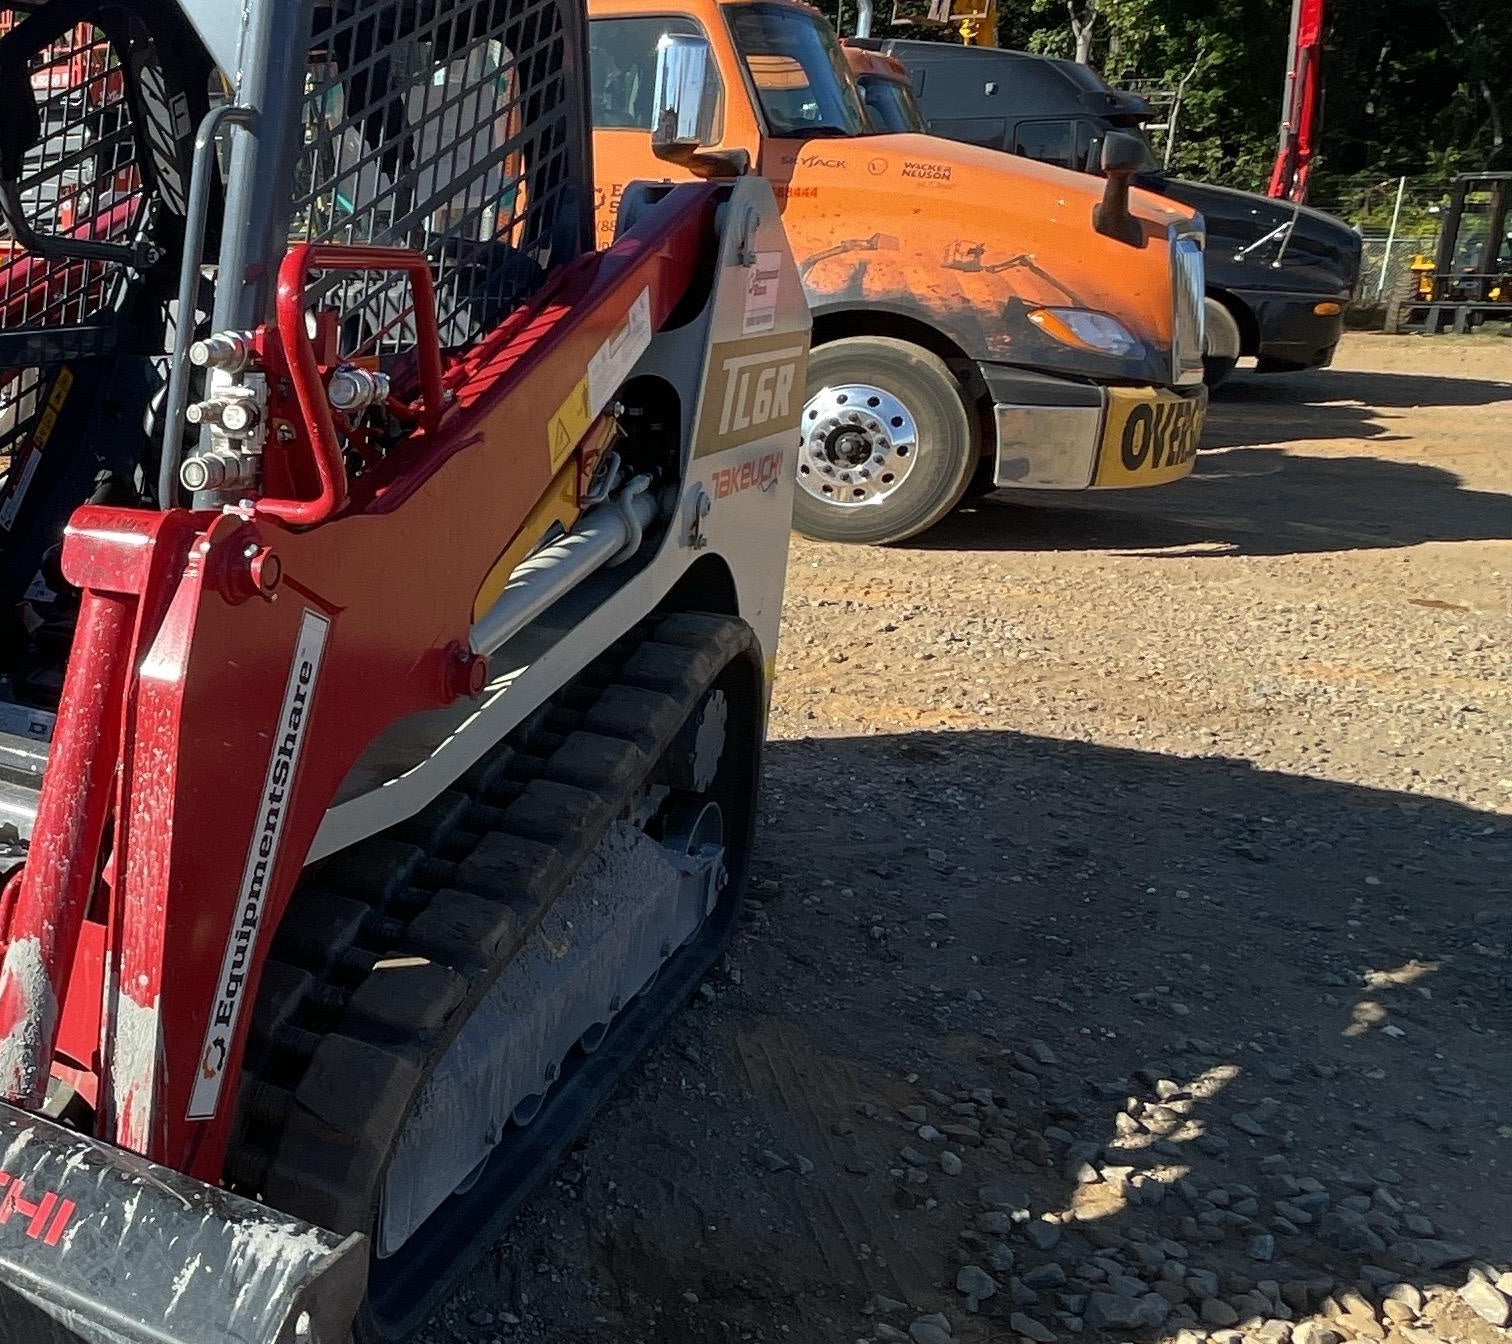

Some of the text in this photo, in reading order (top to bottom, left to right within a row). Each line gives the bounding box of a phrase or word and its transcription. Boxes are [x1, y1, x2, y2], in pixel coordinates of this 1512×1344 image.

[901, 168, 951, 180] NEUSON
[718, 345, 804, 436] TL6R
[213, 660, 313, 1030] EquipmentShare
